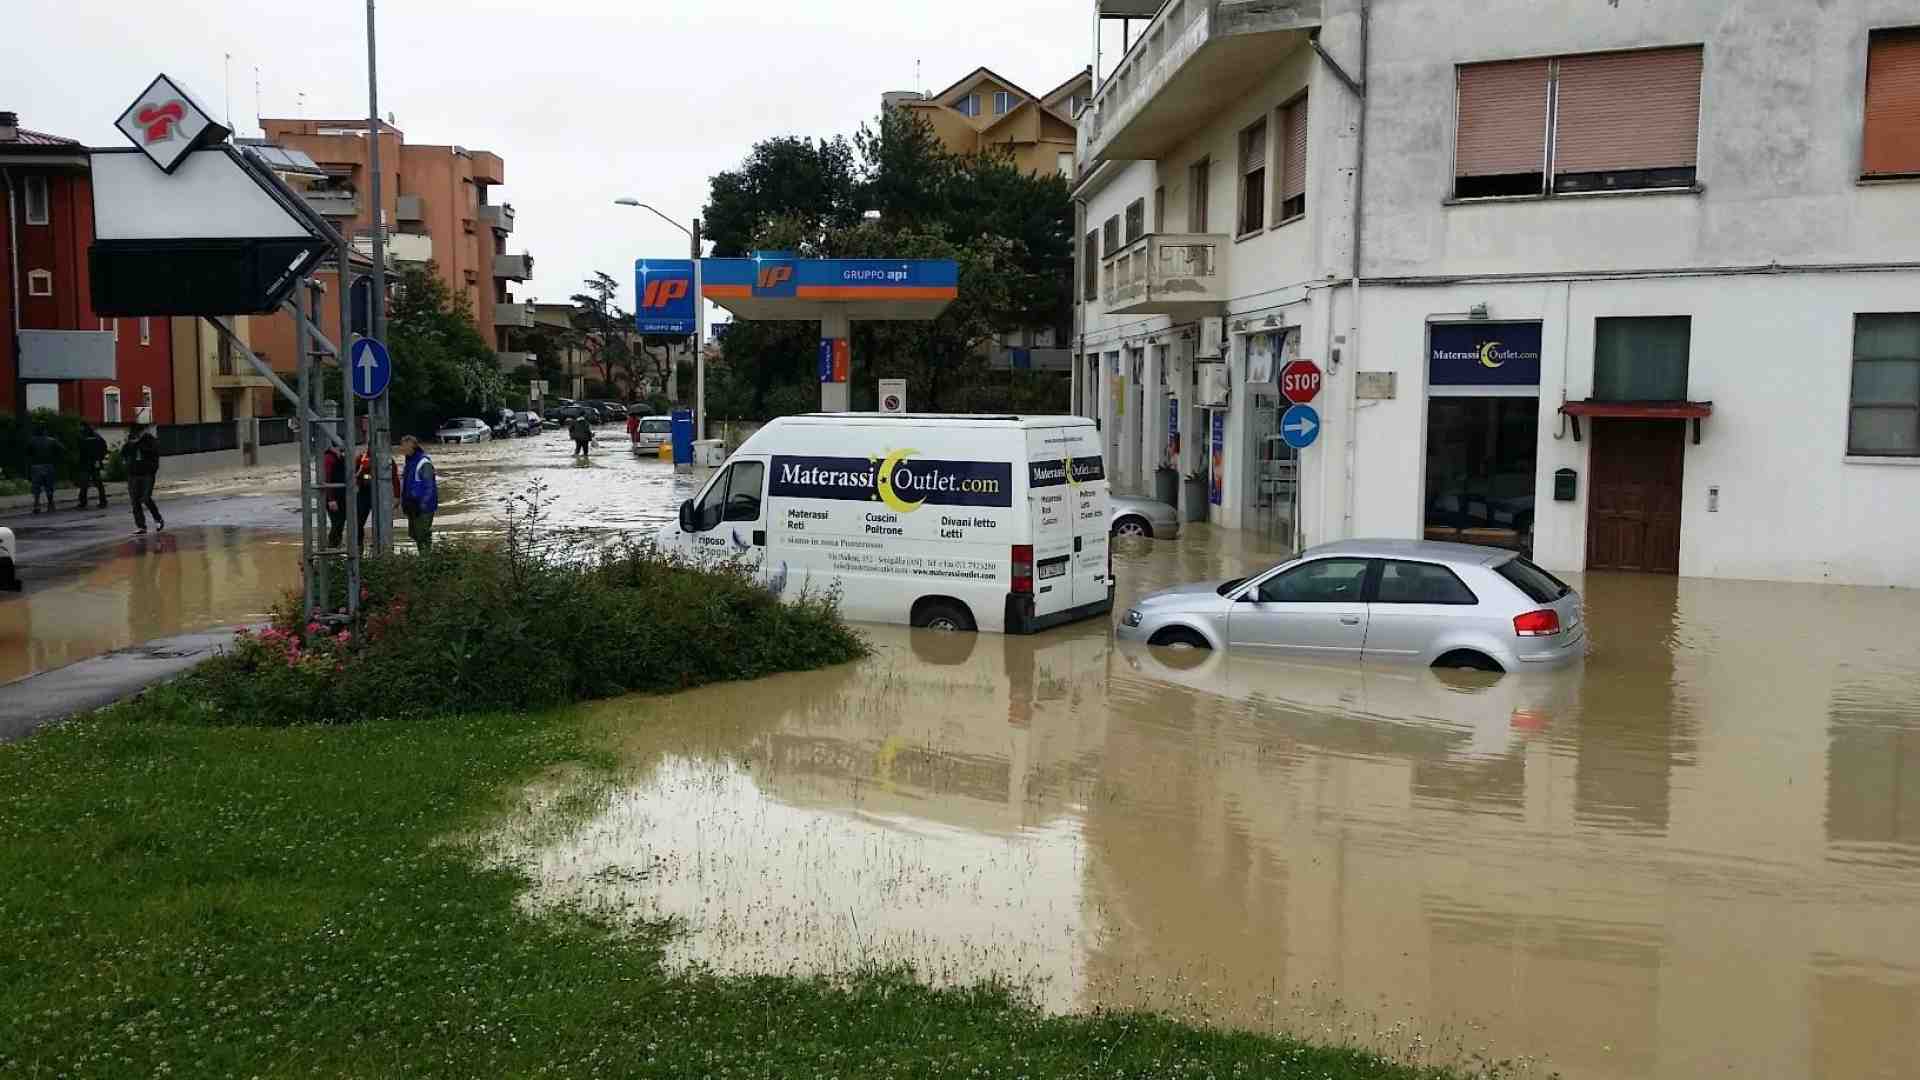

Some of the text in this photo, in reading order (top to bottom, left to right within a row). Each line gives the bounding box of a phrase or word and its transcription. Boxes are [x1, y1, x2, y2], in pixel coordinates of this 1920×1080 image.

[757, 266, 792, 288] IP
[843, 264, 907, 281] GRUPPO api
[642, 280, 688, 307] IP
[1433, 349, 1480, 360] Materassi
[1285, 373, 1320, 391] STOP
[780, 463, 1000, 493] Materassi Outlet.com
[788, 509, 829, 520] Materassi
[865, 512, 898, 523] Cuscini
[788, 520, 804, 530] Reti
[941, 516, 996, 528] Divani letto
[865, 524, 903, 536] Poltrone
[941, 528, 963, 539] Letti
